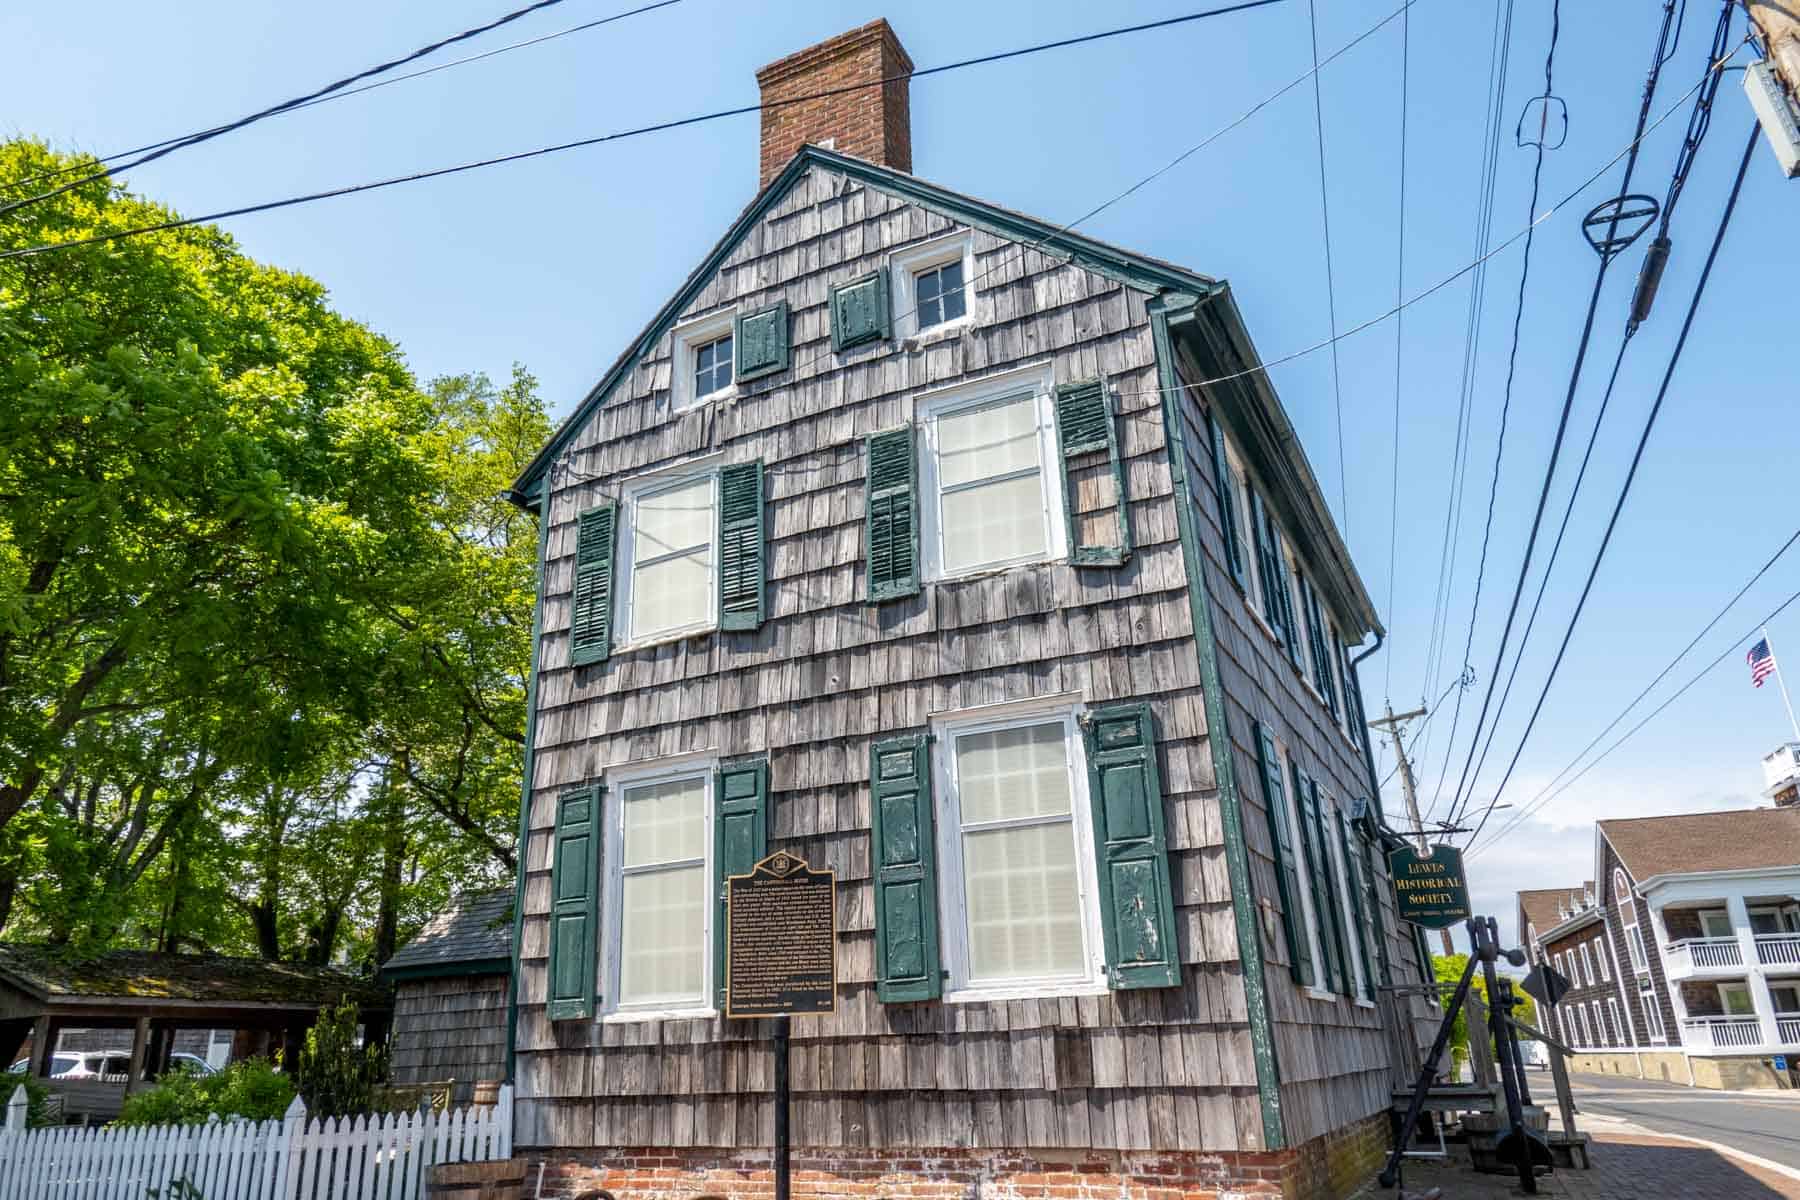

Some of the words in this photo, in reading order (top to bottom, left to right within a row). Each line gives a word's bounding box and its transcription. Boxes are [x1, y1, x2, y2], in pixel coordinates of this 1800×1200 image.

[1408, 863, 1445, 874] LEWES
[1396, 877, 1462, 890] HISTORICAL
[1408, 893, 1453, 904] SOCIETY
